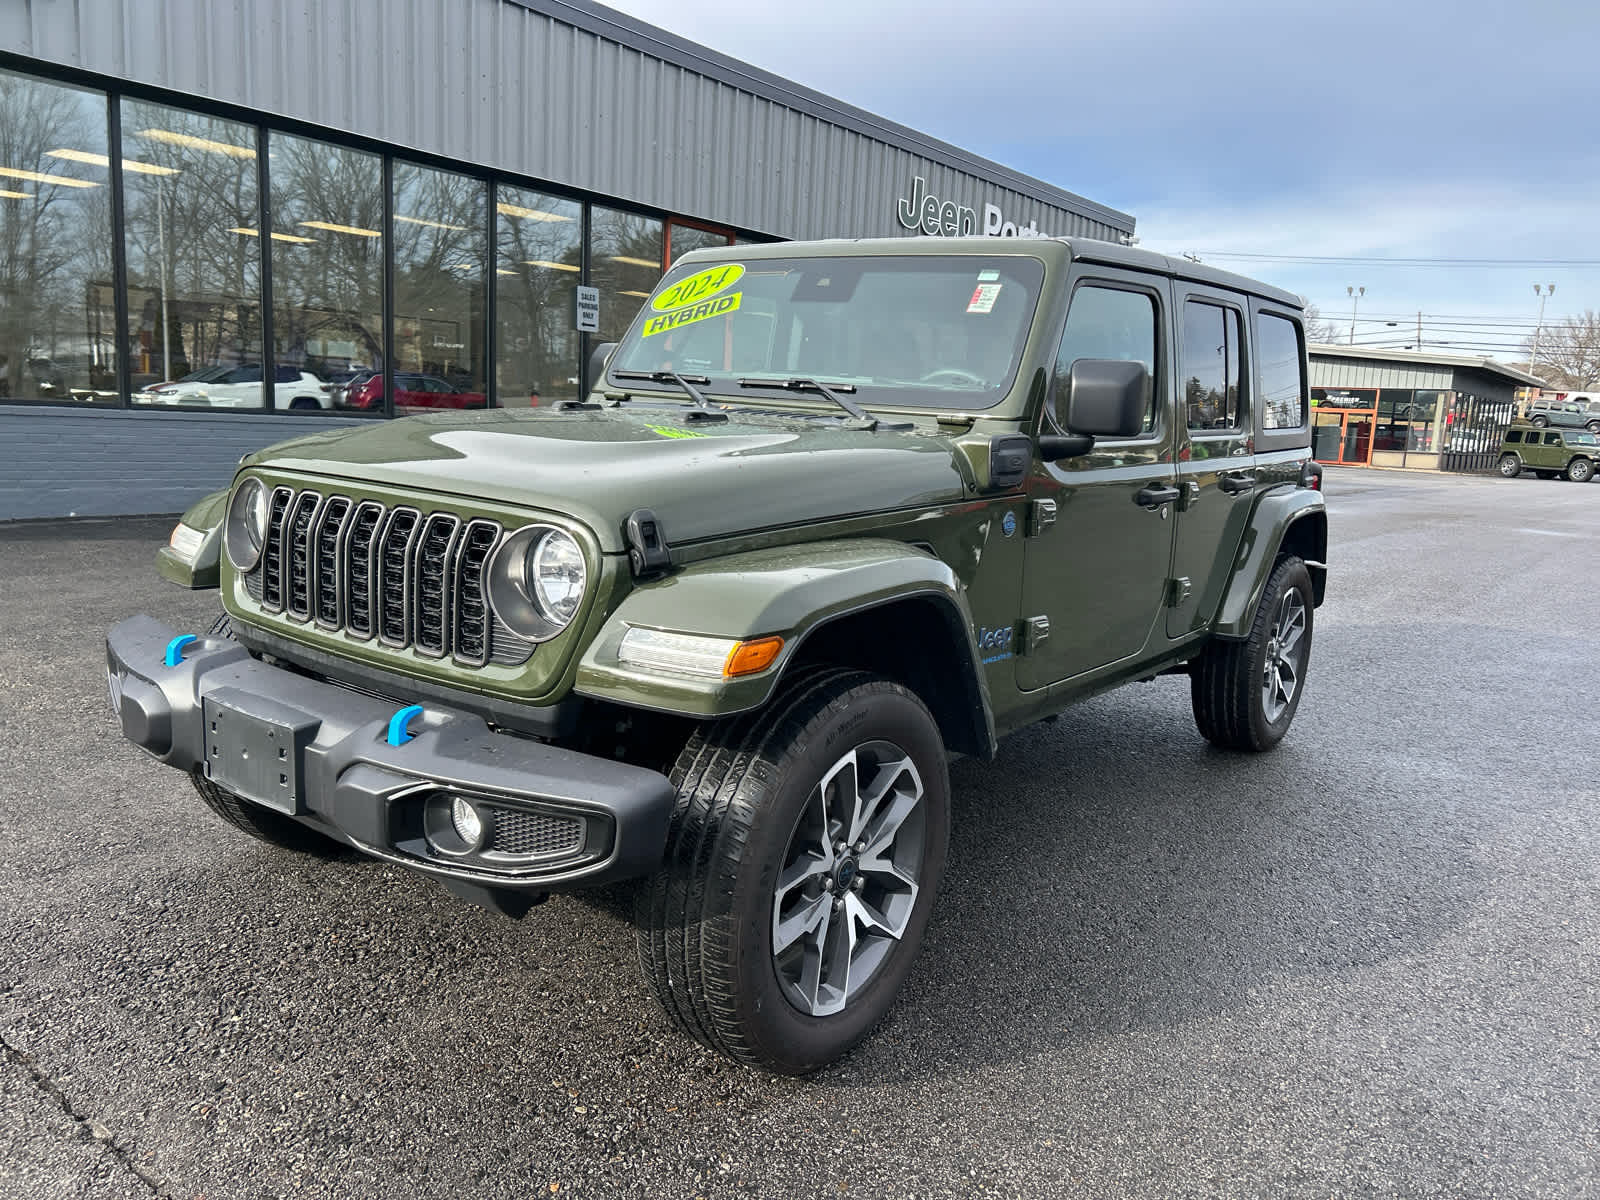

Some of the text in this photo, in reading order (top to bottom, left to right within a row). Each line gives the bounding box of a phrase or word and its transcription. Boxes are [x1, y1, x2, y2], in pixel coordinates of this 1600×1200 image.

[898, 176, 977, 238] Jeep
[580, 292, 596, 302] SALES
[663, 266, 731, 308] 2024
[582, 311, 594, 320] ONLY
[649, 296, 735, 333] HYBRID
[978, 626, 1012, 651] Jeep
